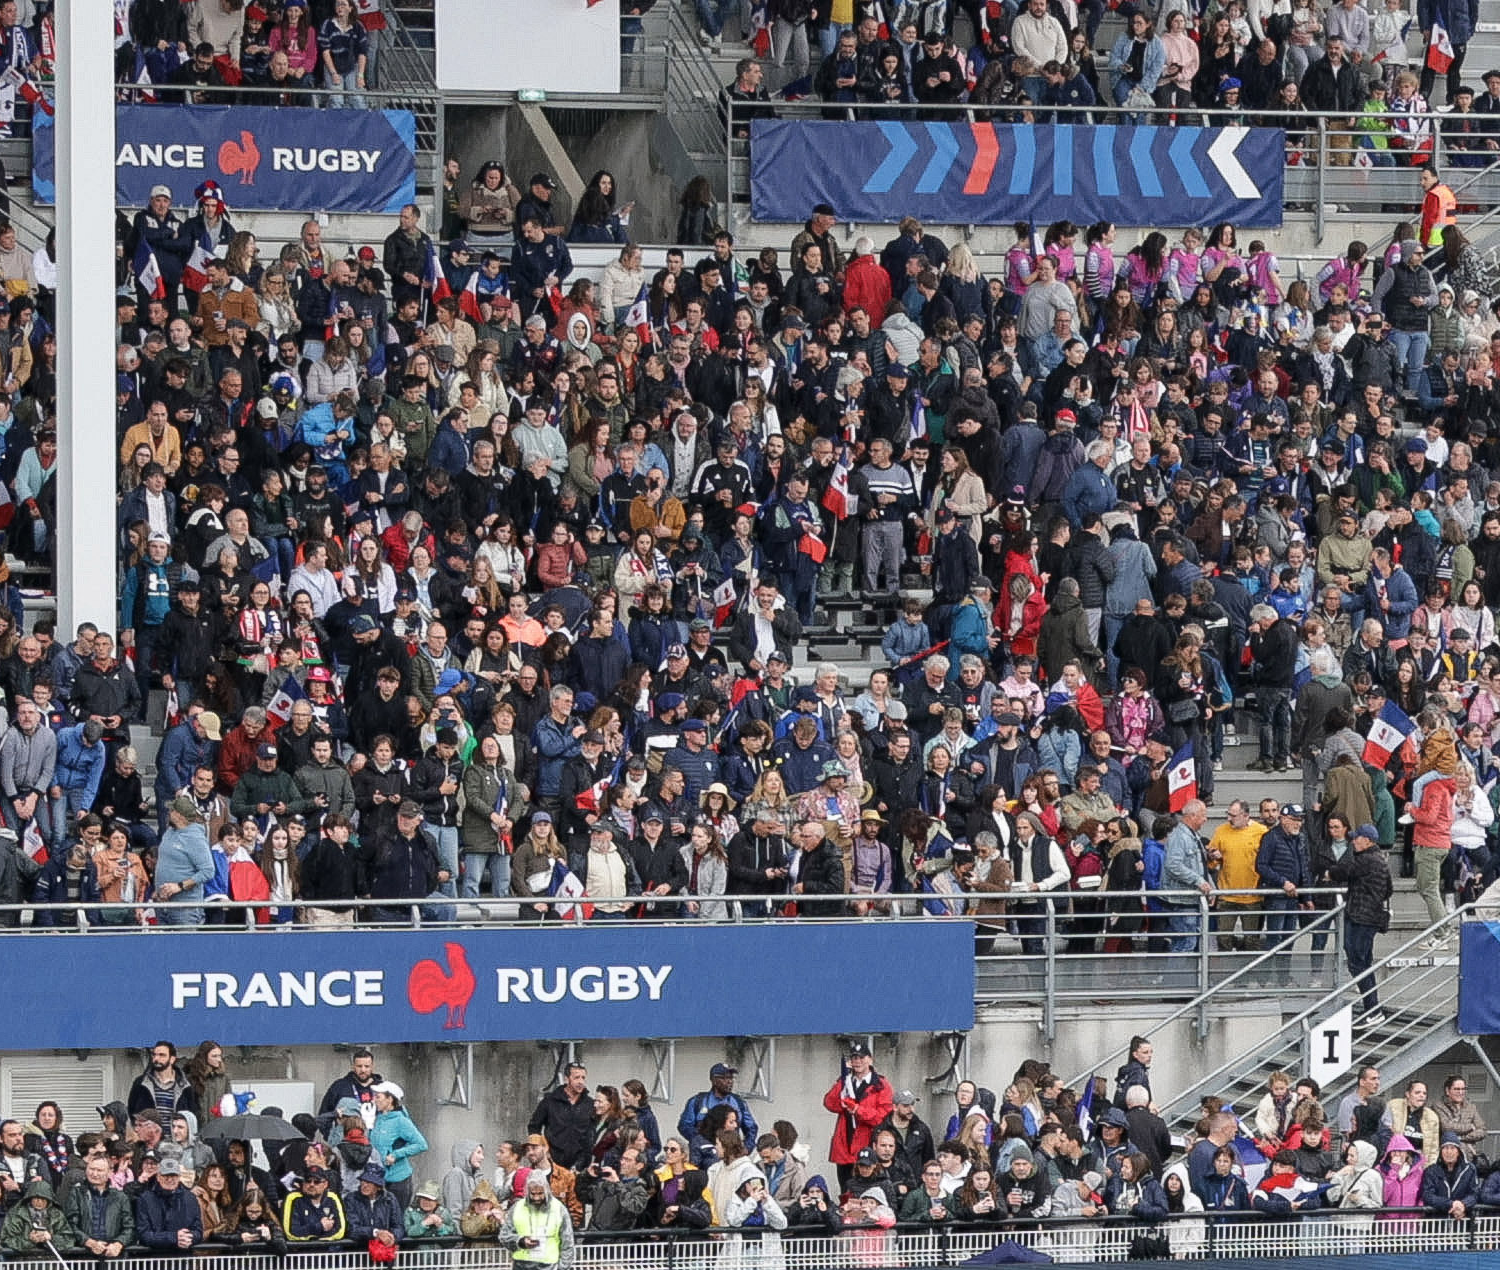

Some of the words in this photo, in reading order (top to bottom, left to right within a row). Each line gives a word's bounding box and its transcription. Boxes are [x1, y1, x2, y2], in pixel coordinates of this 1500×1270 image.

[116, 144, 205, 168] ANCE
[273, 147, 381, 172] RUGBY
[171, 970, 384, 1009] FRANCE
[496, 965, 672, 1004] RUGBY
[1323, 1030, 1339, 1064] I
